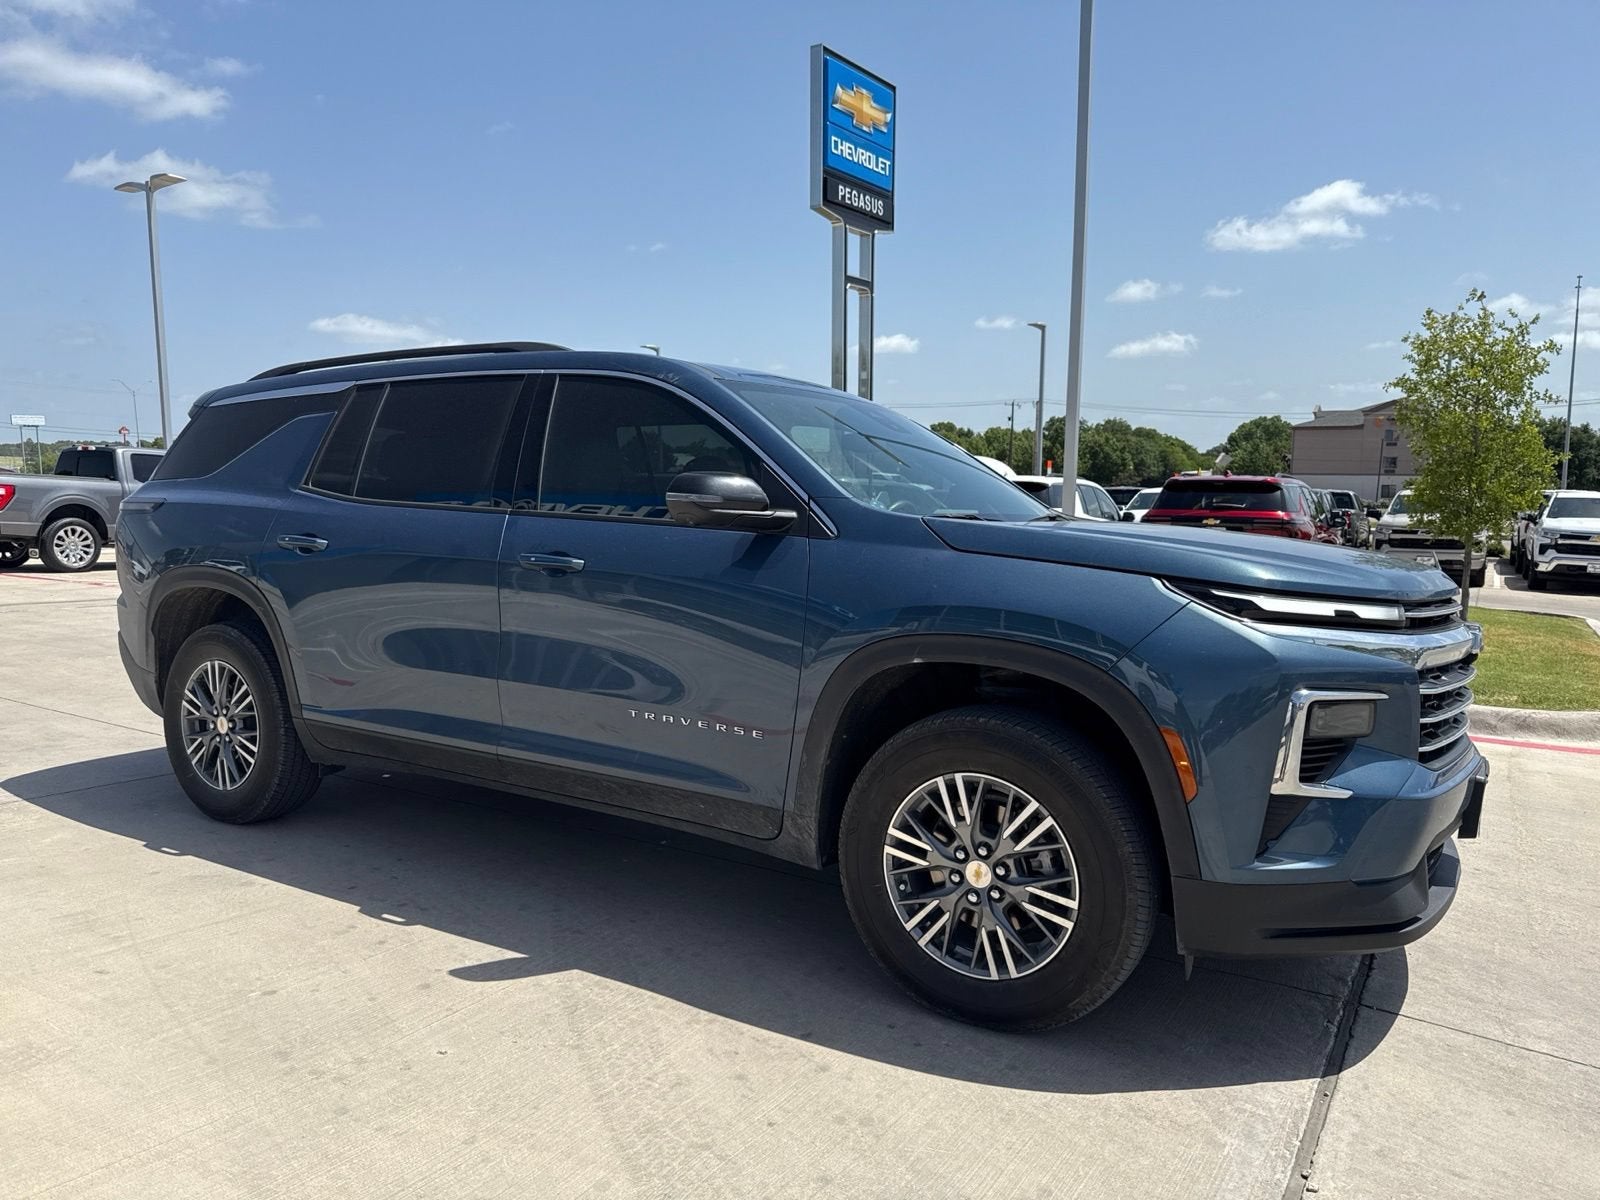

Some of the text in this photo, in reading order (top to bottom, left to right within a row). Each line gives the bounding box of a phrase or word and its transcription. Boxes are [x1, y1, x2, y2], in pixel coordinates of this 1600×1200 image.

[831, 136, 891, 176] CHEVROLET
[838, 184, 884, 216] PEGASUS
[628, 709, 764, 740] TRAVERSE
